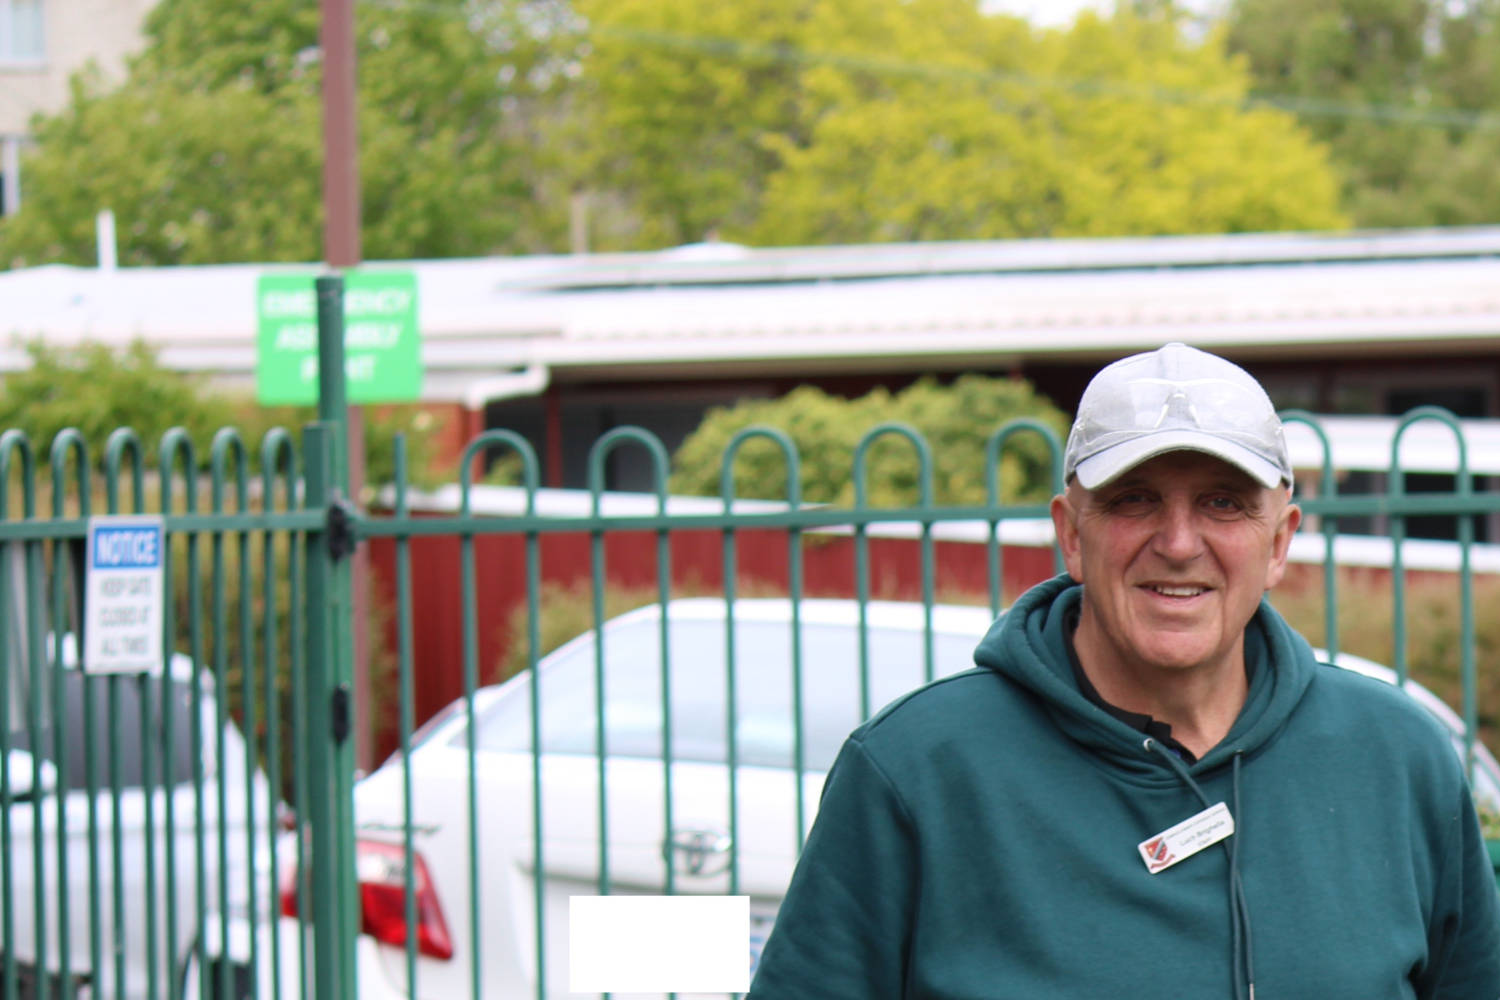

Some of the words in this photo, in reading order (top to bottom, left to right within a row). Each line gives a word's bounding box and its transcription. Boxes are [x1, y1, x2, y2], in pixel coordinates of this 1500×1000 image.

[263, 289, 411, 316] EMEENCY
[301, 355, 376, 381] PNT
[97, 531, 156, 564] NOTICE
